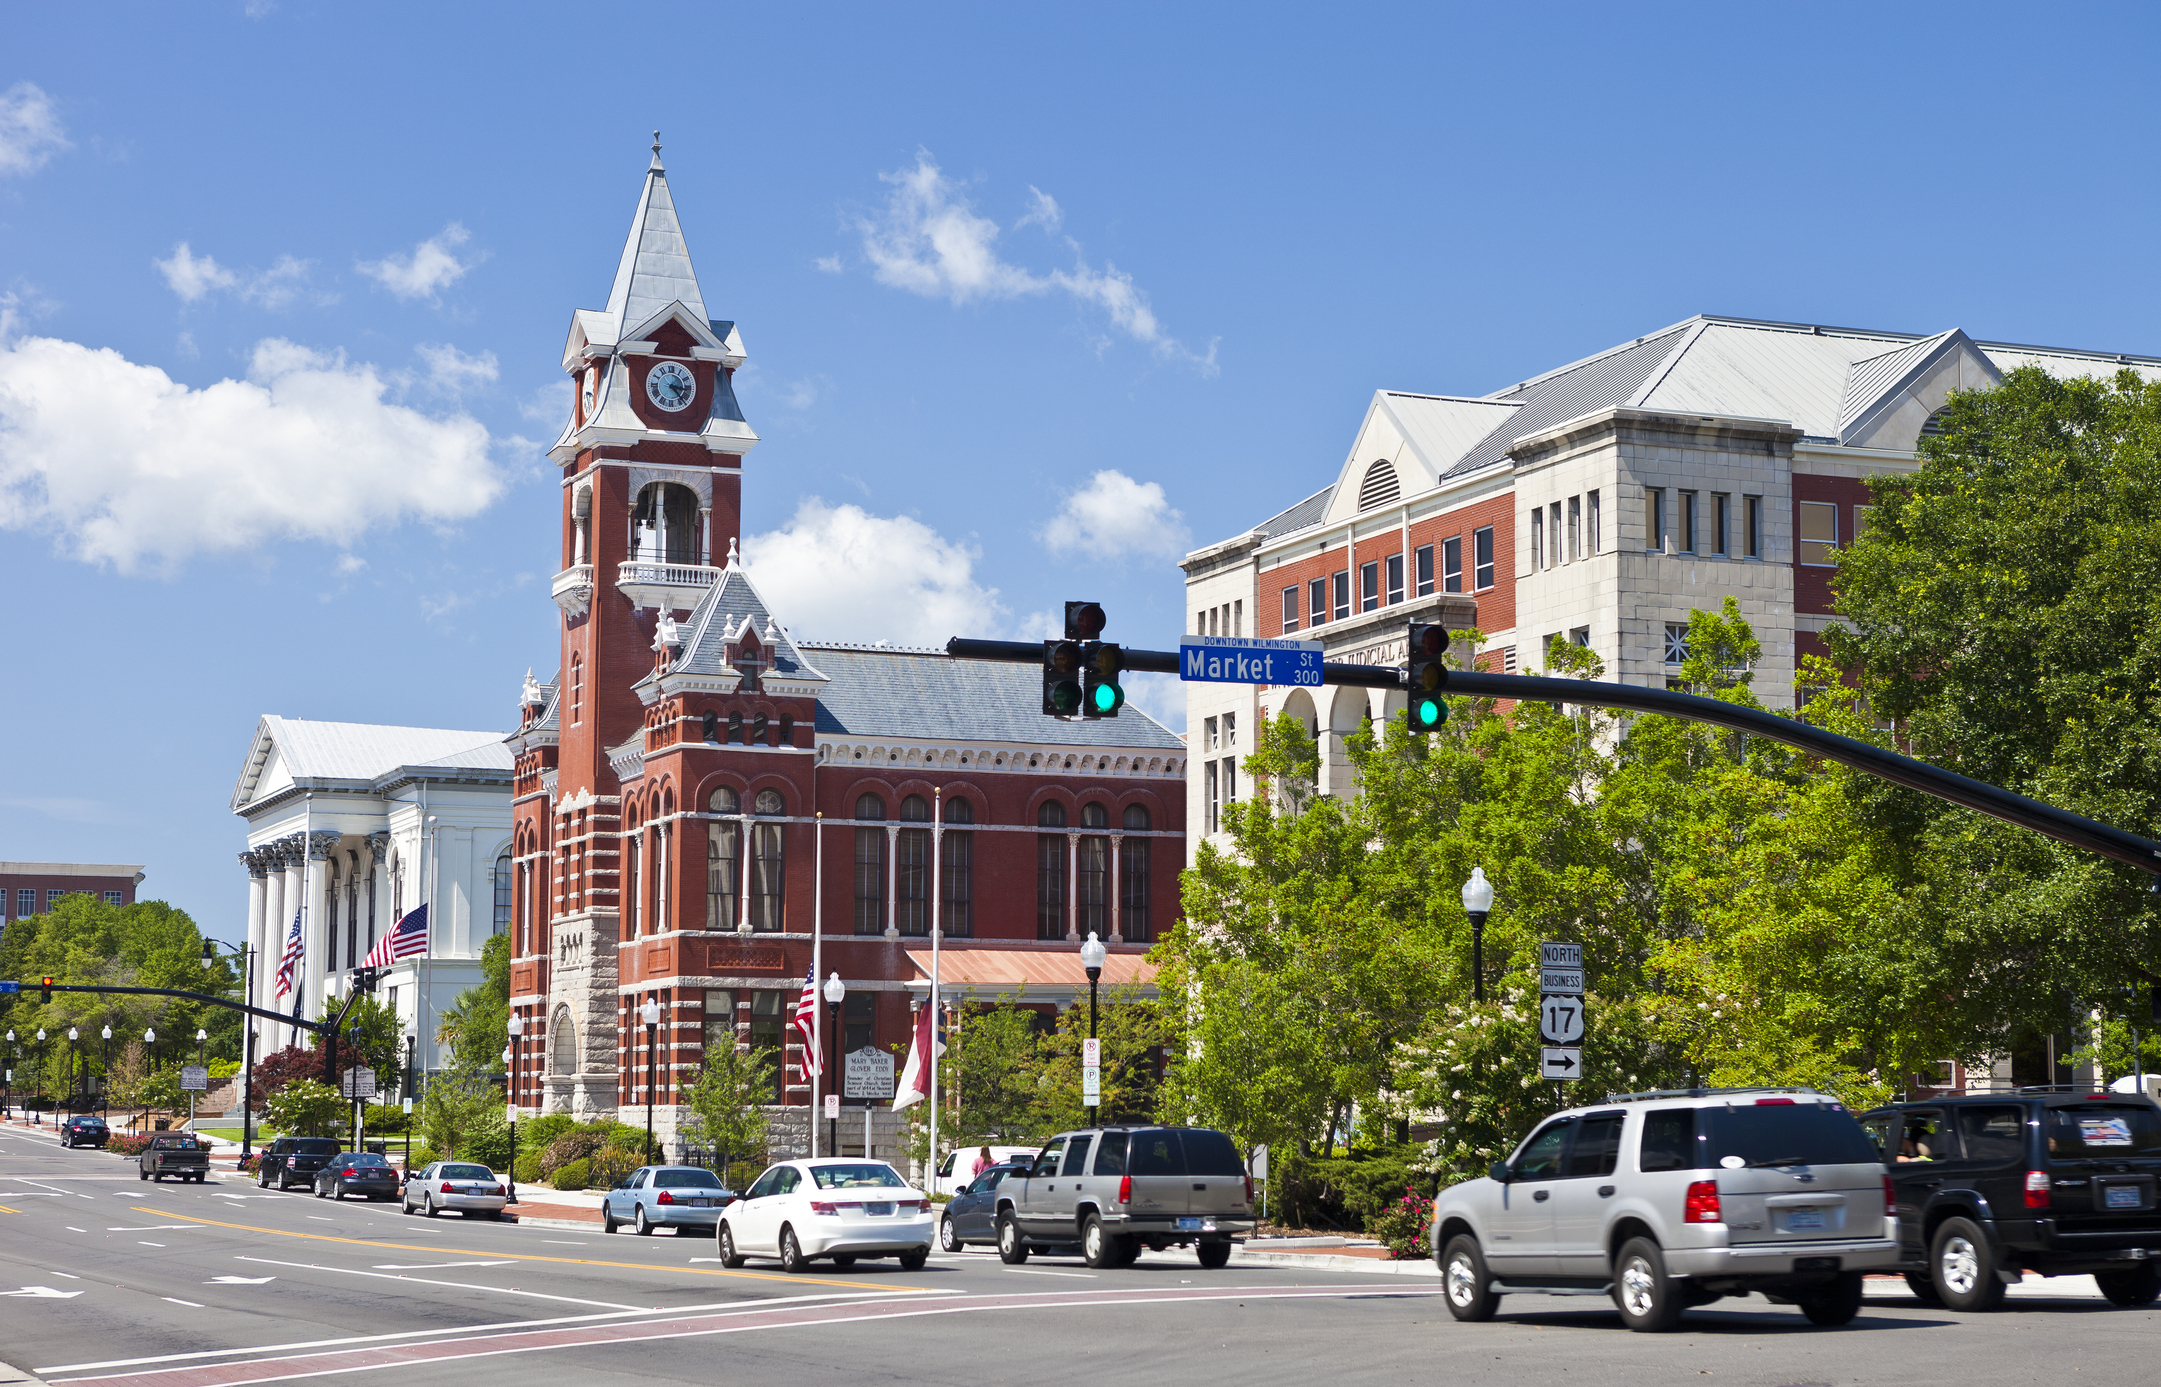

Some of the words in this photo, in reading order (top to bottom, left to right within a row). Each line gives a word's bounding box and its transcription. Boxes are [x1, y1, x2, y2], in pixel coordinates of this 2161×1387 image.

[1204, 636, 1249, 648] DOWNTOWN
[1252, 638, 1300, 650] WILMINGTON
[1300, 652, 1313, 667] St
[1348, 644, 1395, 666] JUDICIAL
[1187, 649, 1274, 680] Market
[1294, 669, 1319, 684] 300
[1544, 947, 1580, 962] NORTH
[1544, 974, 1580, 988] BUSINESS
[1549, 1006, 1575, 1034] 17
